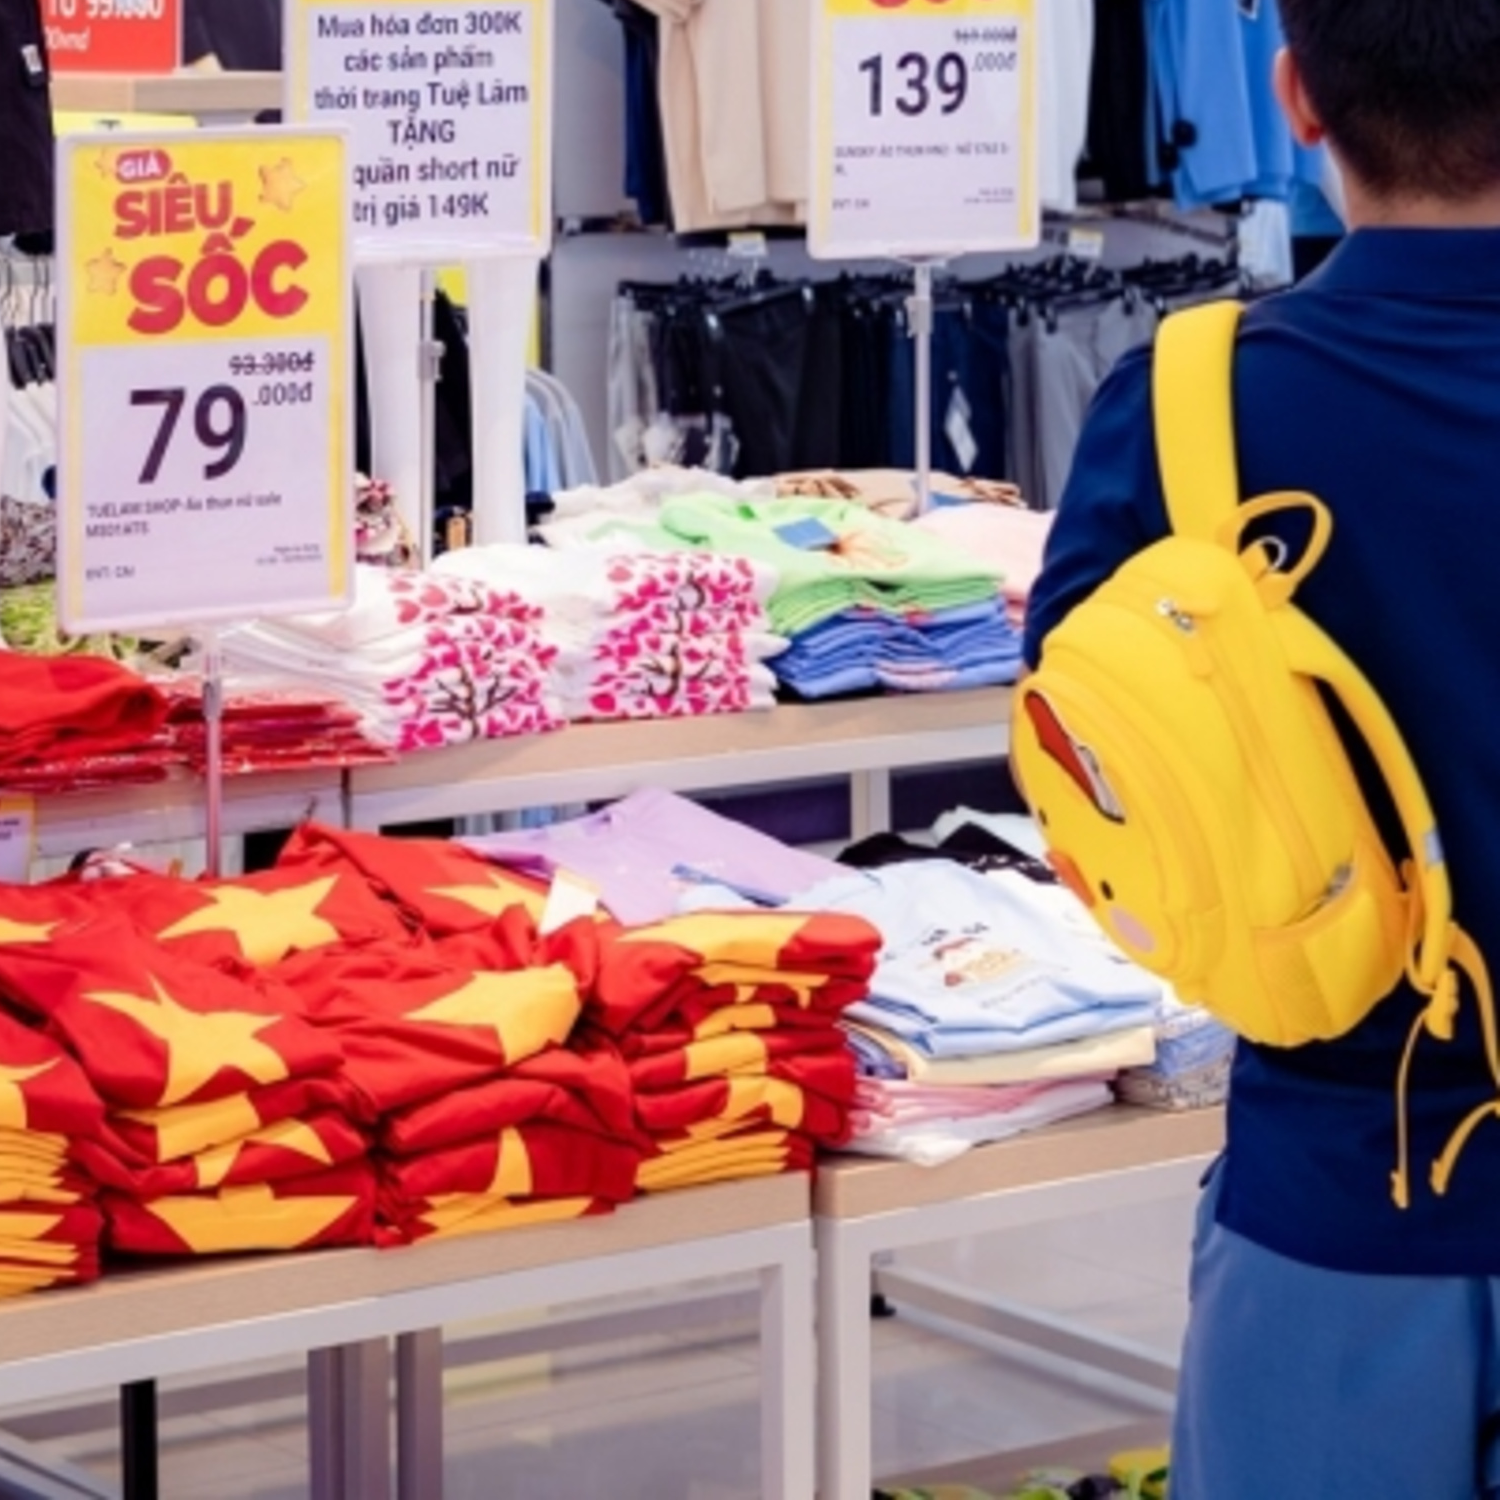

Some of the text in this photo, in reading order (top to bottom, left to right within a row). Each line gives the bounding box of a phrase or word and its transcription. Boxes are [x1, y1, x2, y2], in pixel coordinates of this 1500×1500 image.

[317, 14, 365, 38] Mua
[370, 12, 410, 35] hóa
[465, 11, 522, 35] 300K
[344, 49, 383, 73] các
[363, 86, 421, 114] trang
[857, 50, 969, 117] 139
[417, 156, 479, 182] short
[113, 172, 232, 240] SIÊU
[383, 193, 421, 227] giá
[428, 191, 489, 219] 149K
[126, 216, 309, 335] SỐC
[129, 383, 248, 484] 79
